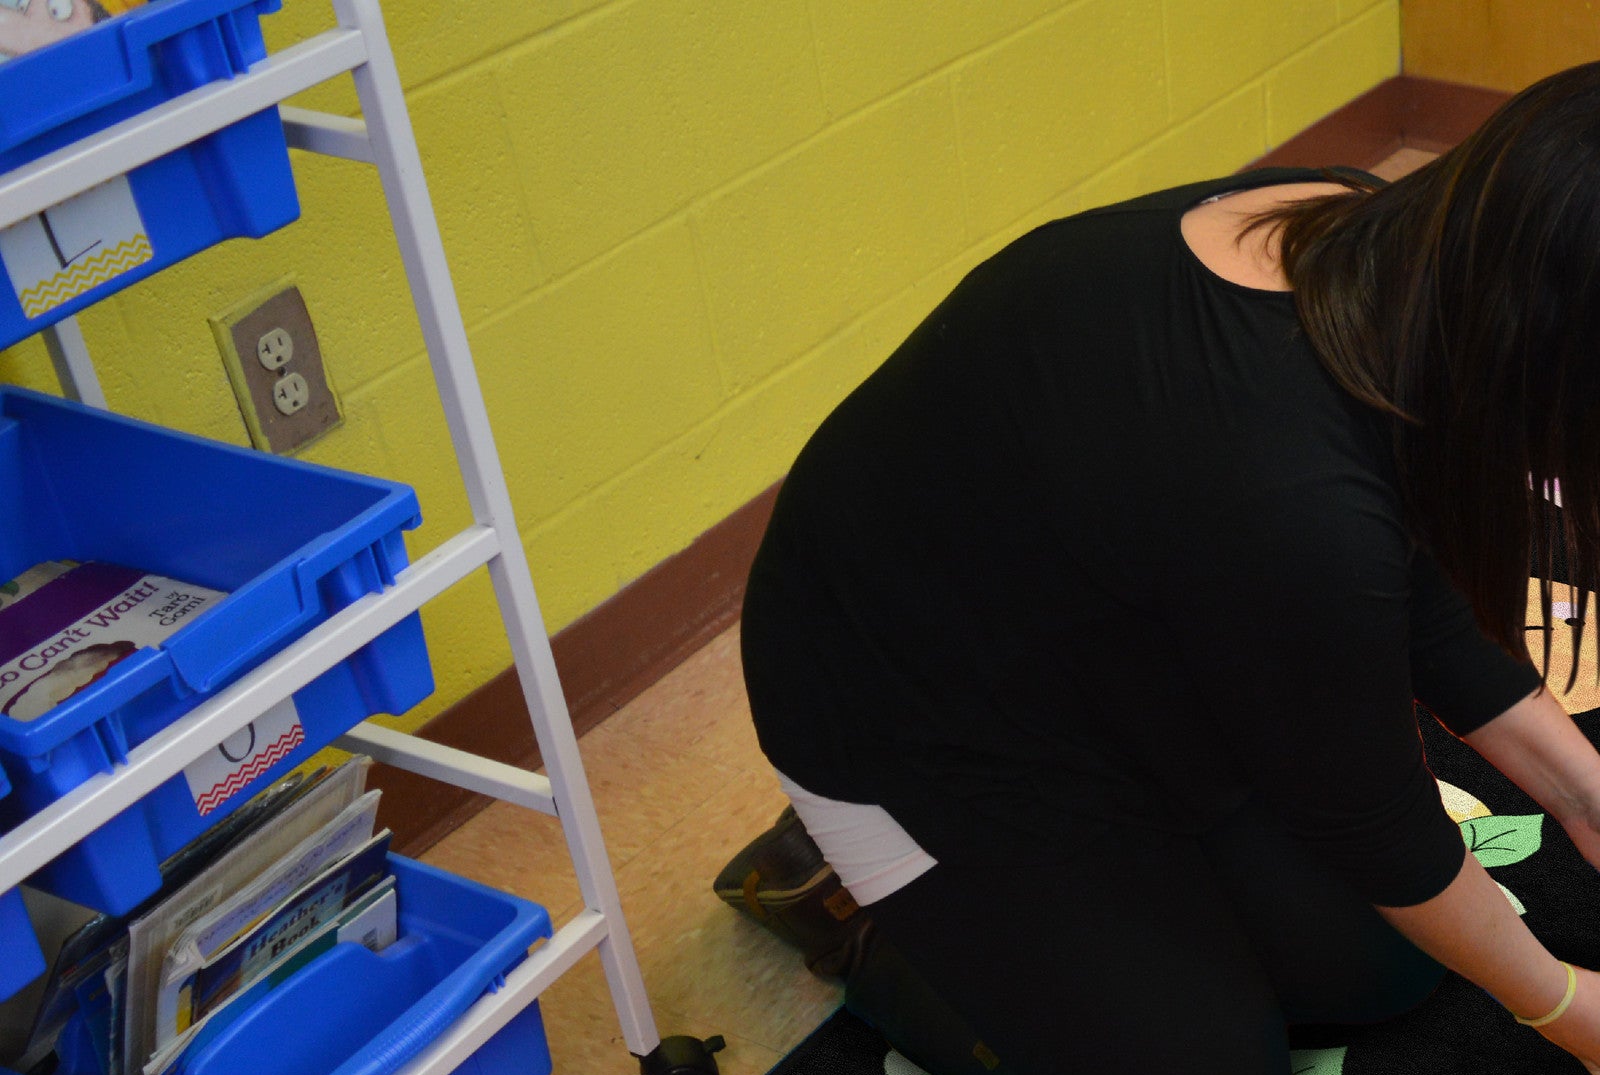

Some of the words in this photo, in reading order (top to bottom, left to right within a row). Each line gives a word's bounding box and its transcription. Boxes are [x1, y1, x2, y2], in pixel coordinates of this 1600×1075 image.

[19, 627, 91, 671] Can't
[86, 580, 160, 628] Wait!
[149, 594, 190, 618] Taro
[159, 596, 206, 626] Gomi
[250, 882, 344, 958] Heather's
[271, 915, 321, 959] Book
